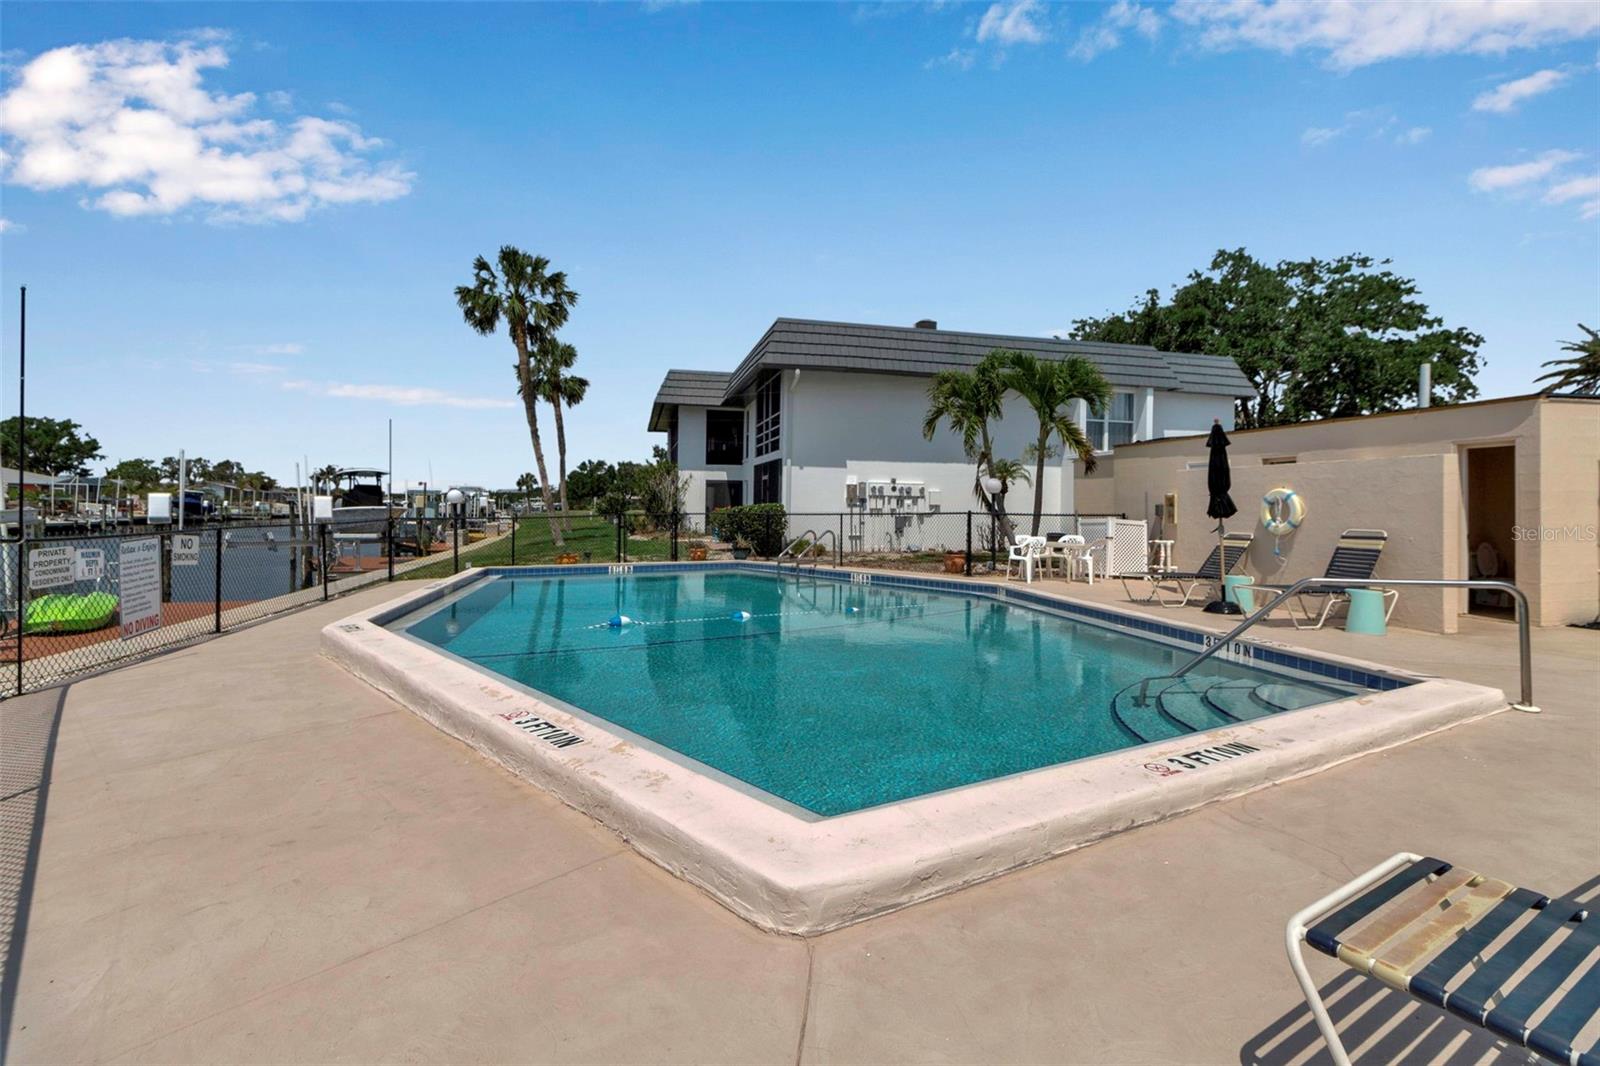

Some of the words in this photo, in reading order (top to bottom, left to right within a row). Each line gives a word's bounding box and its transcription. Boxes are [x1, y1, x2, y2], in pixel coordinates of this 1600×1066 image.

[180, 538, 194, 550] NO
[38, 548, 67, 558] PRIVATE
[173, 552, 199, 562] SMOKING
[33, 557, 71, 569] PROPERTY
[60, 575, 73, 583] ONLY
[124, 622, 134, 636] NO
[135, 613, 159, 632] DIVING
